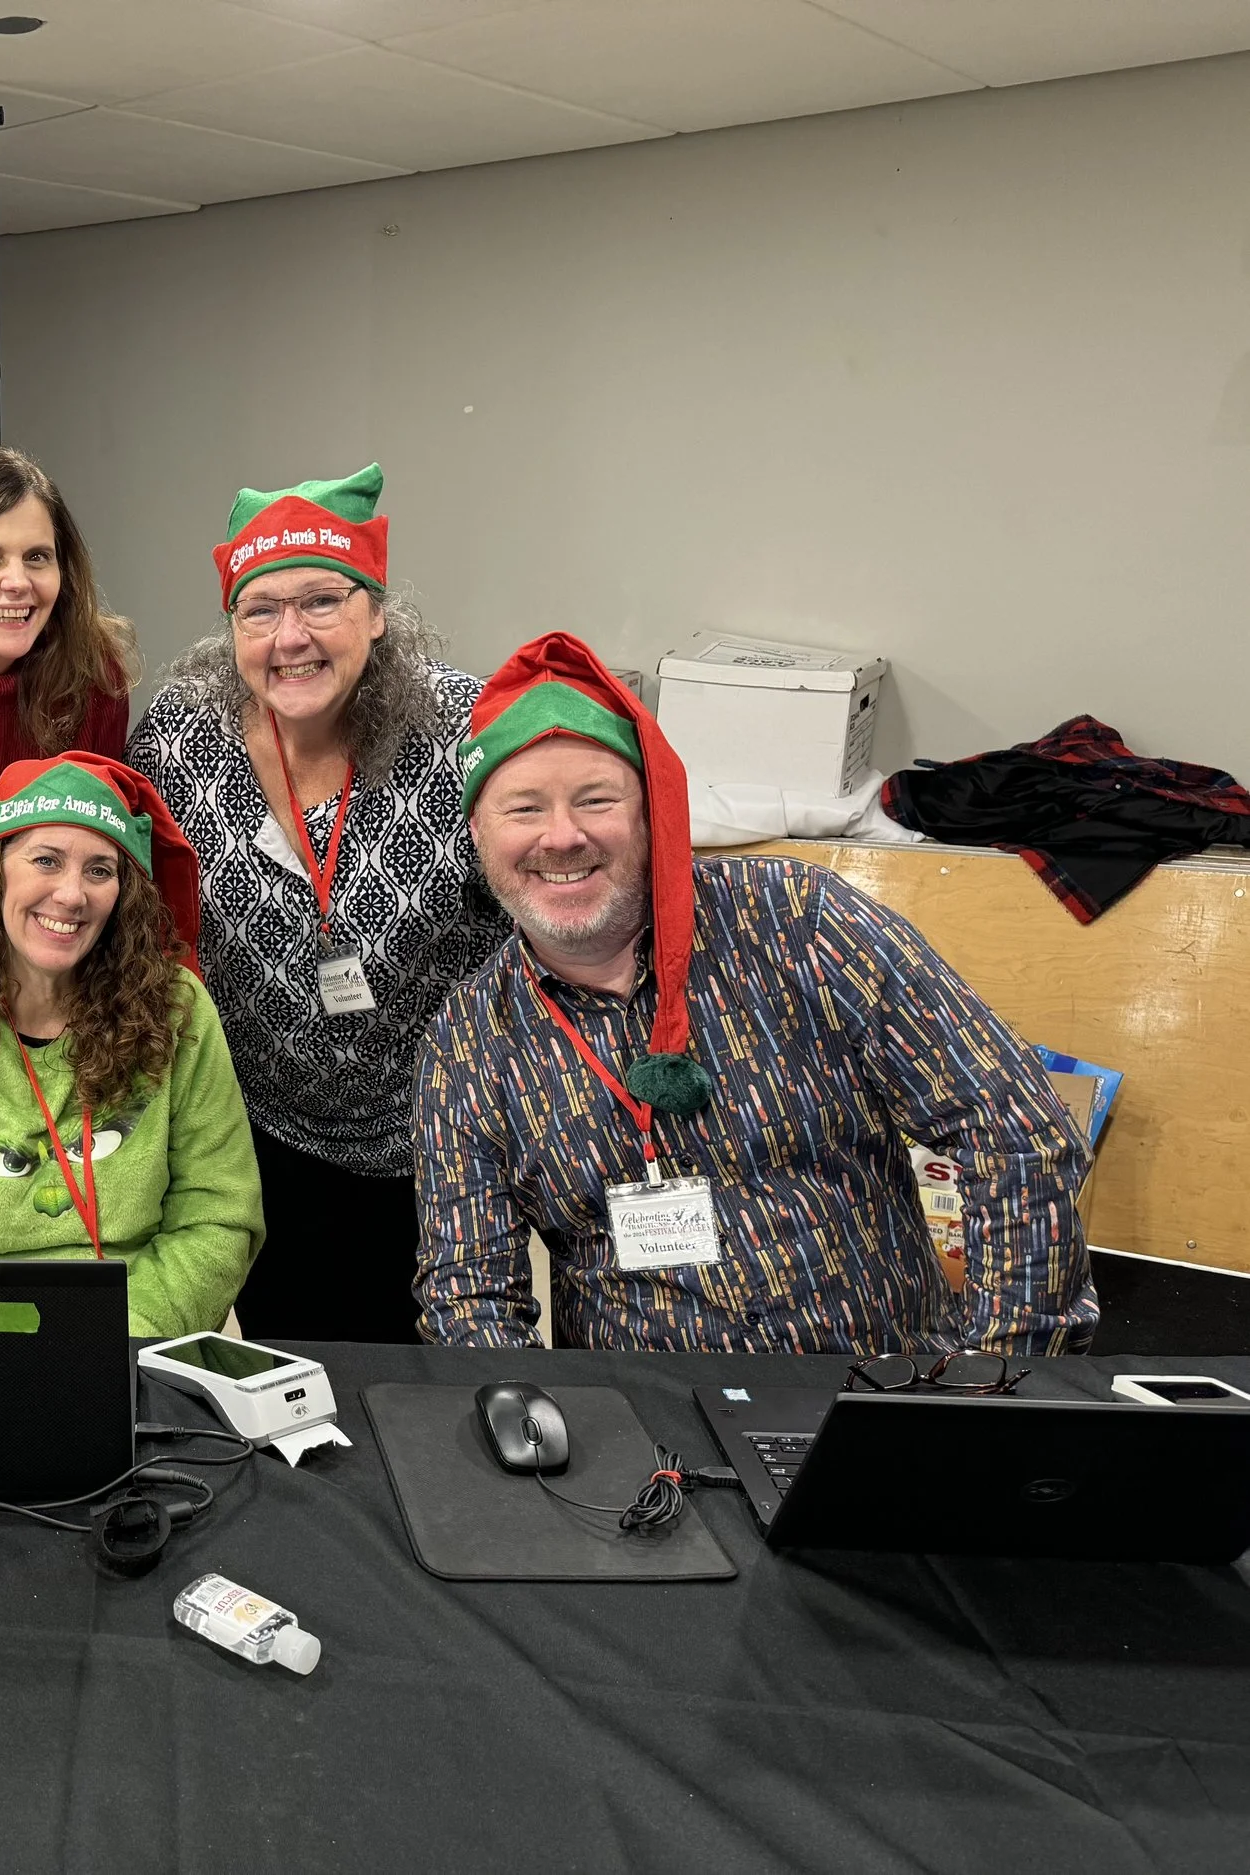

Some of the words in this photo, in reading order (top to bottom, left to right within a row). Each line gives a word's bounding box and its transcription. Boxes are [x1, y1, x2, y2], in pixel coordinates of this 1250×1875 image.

[256, 535, 278, 554] for
[281, 528, 316, 546] Ann's
[319, 527, 351, 550] Place
[37, 796, 60, 811] for
[62, 795, 97, 817] Ann's
[100, 804, 127, 833] Place
[334, 993, 362, 1003] Volunteer
[645, 1227, 676, 1236] FESTIVAL
[639, 1242, 696, 1253] Volunteer
